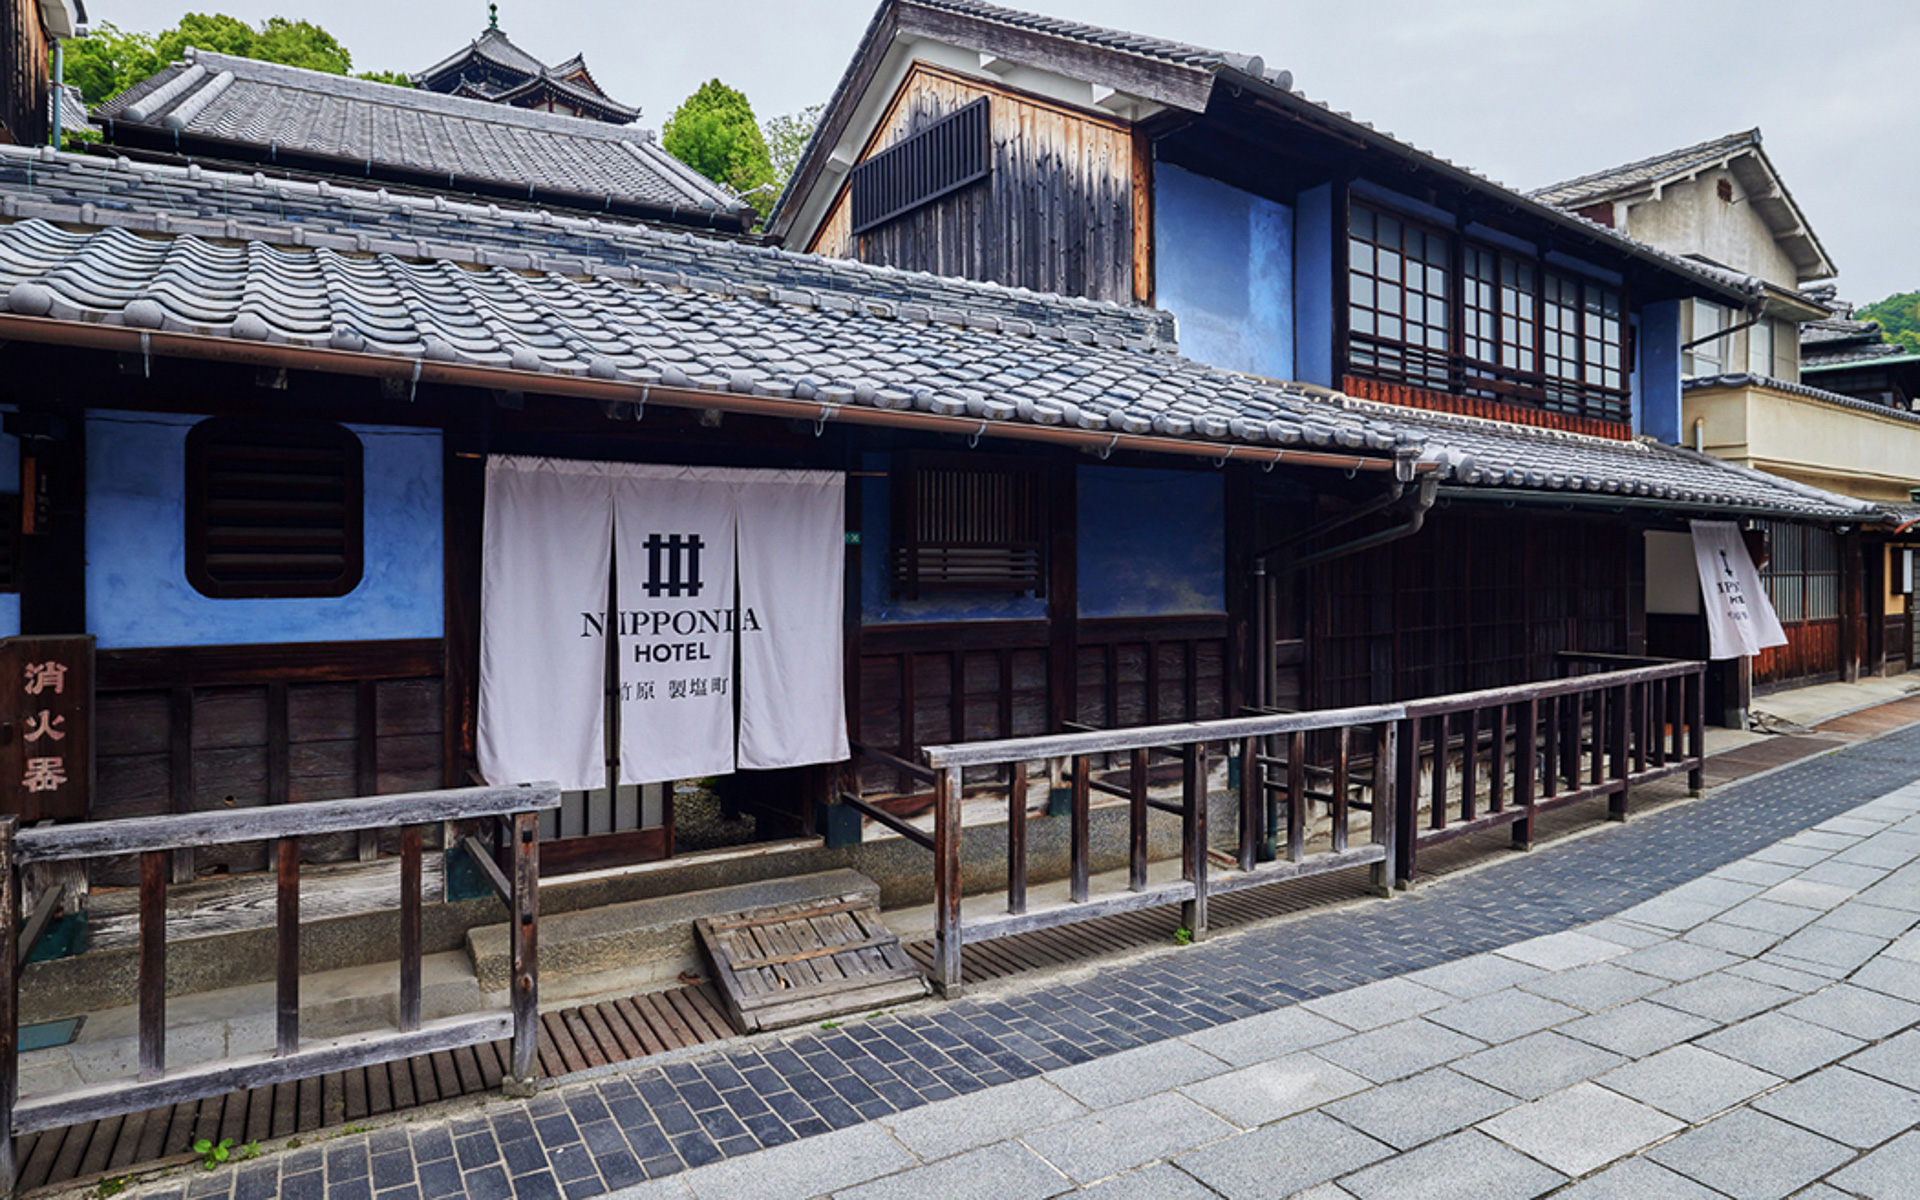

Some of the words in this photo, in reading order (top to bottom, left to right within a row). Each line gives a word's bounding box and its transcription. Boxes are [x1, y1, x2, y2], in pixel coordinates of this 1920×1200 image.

[580, 607, 762, 637] NIPPONIA
[635, 642, 711, 663] HOTEL
[668, 676, 729, 699] 製塩町
[22, 661, 68, 792] 消火器
